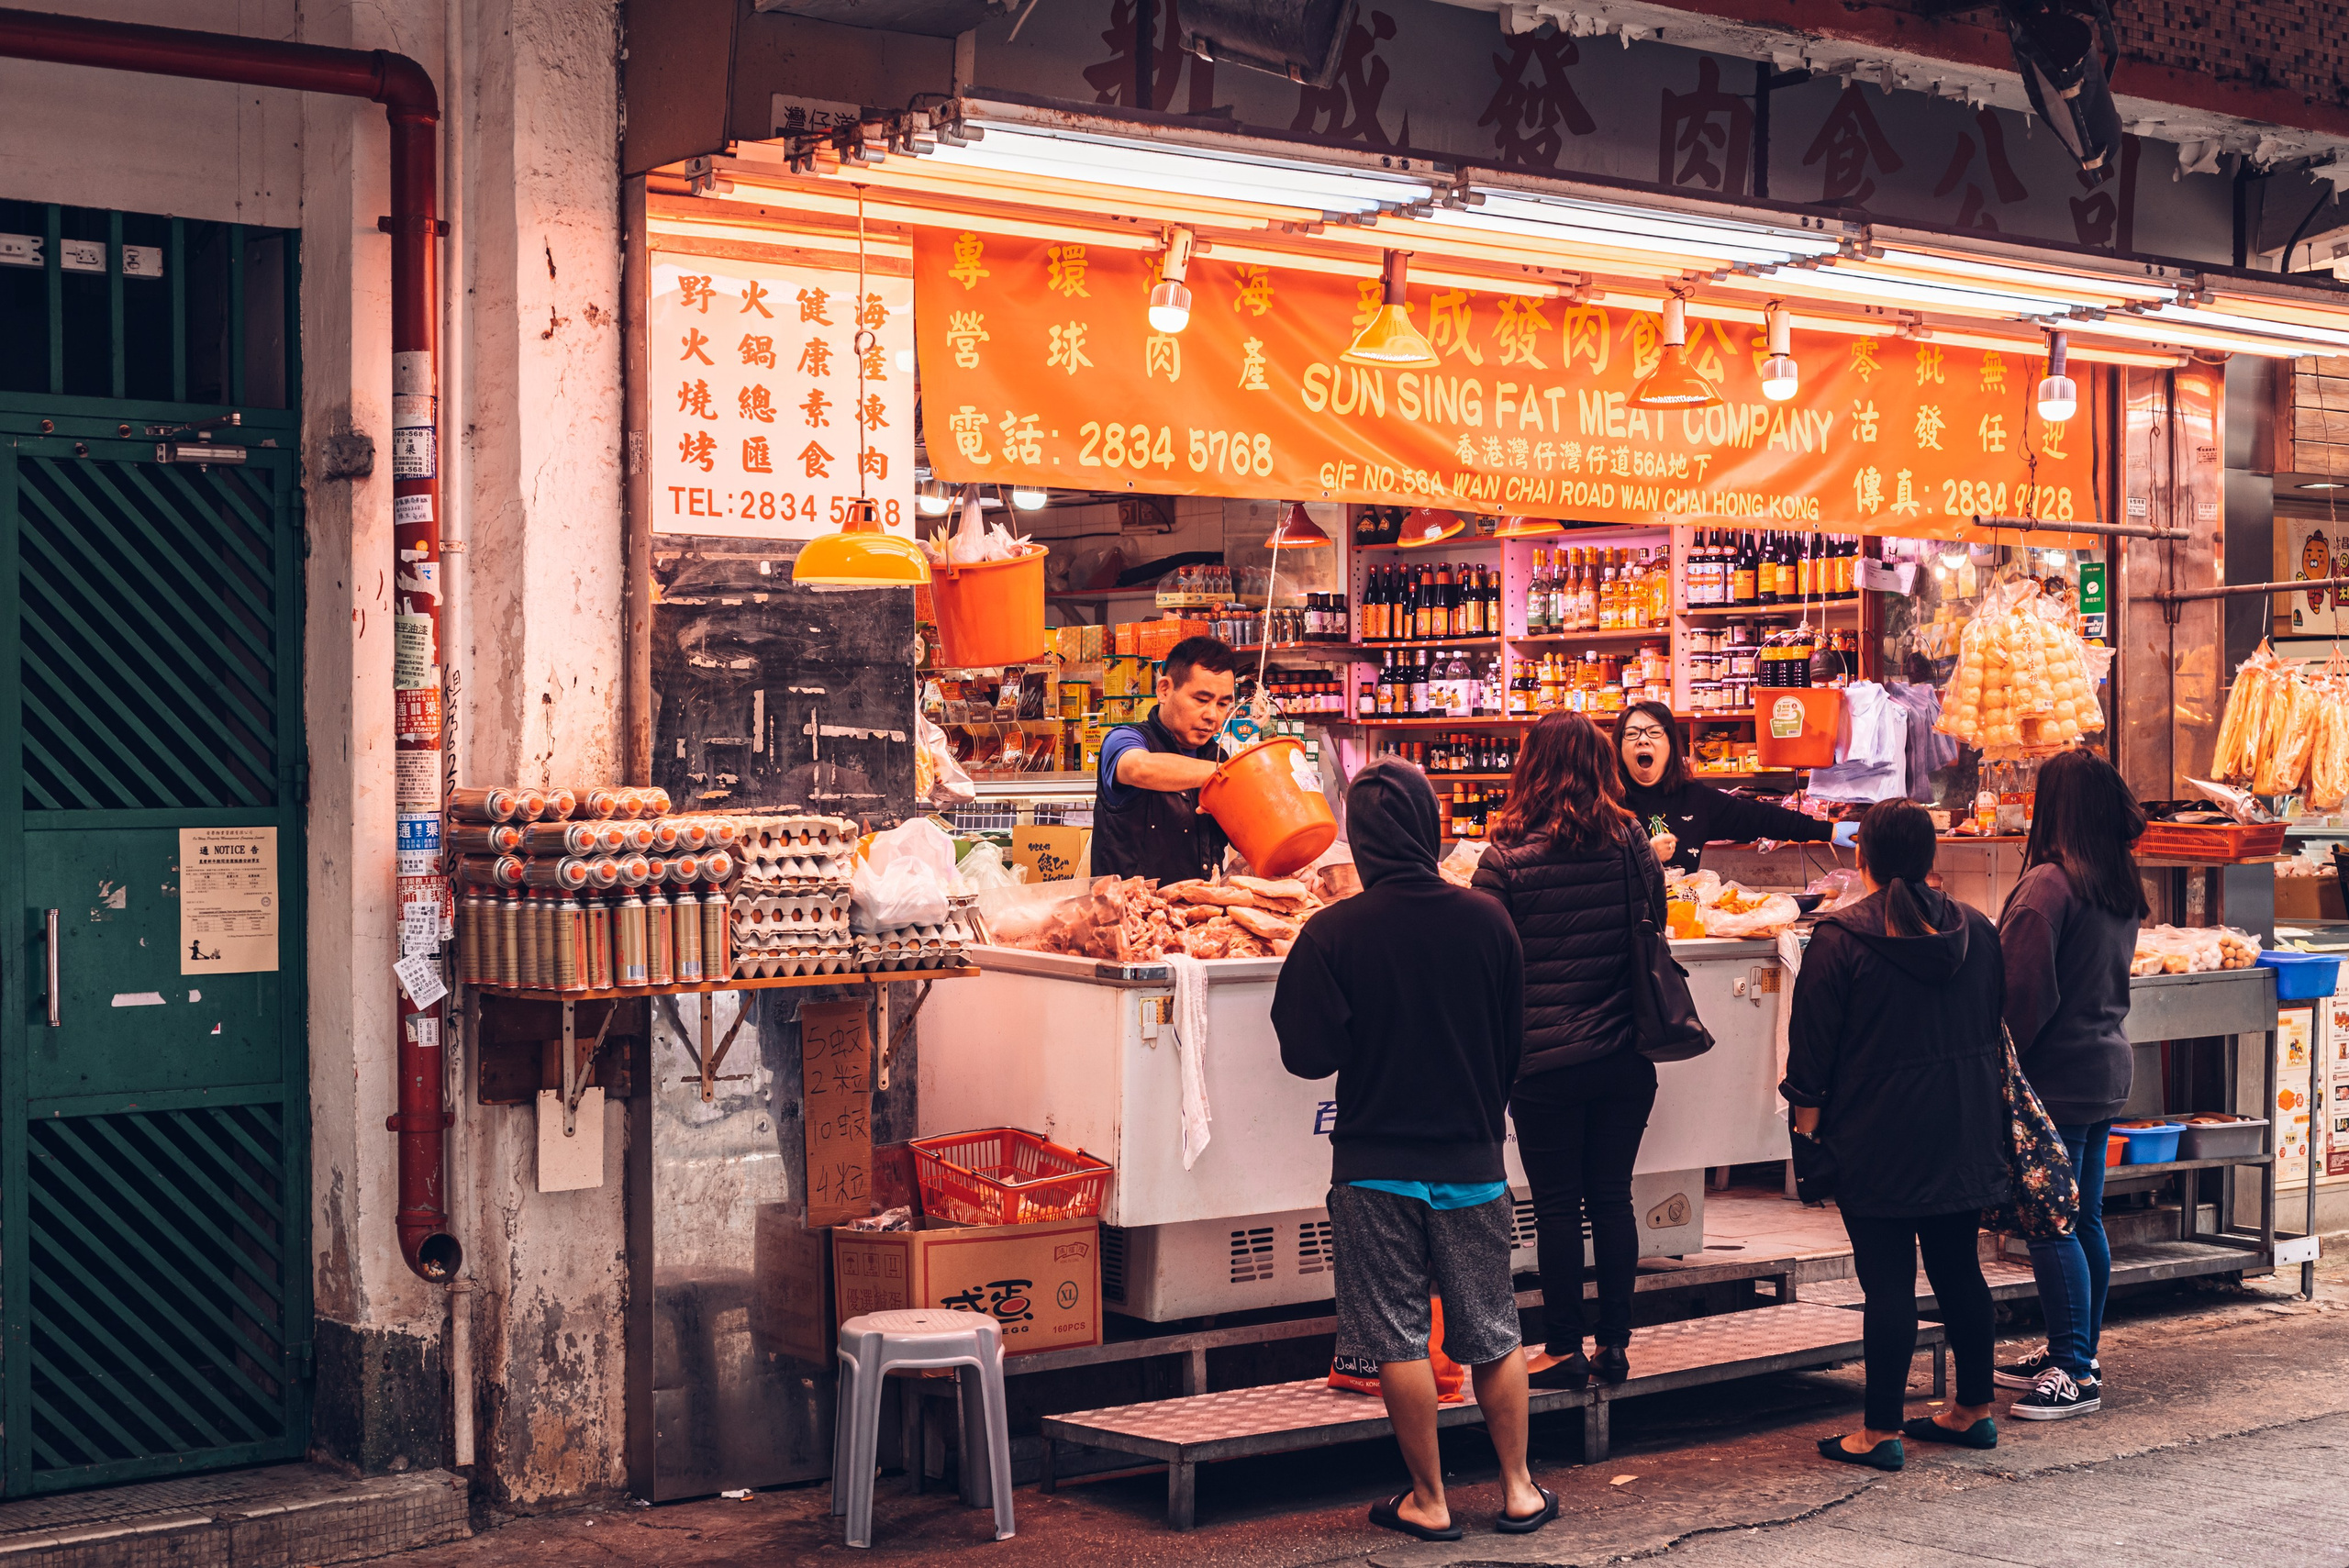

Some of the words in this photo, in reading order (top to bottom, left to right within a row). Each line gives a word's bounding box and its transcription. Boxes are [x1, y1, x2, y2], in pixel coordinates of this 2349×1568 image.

[946, 231, 990, 370] 專營
[1046, 244, 1094, 375] 環球
[1234, 264, 1275, 391] 海產
[677, 275, 718, 473] 野火燒烤
[737, 280, 777, 474] 火鍋總匯
[796, 287, 835, 479] 健康素食
[854, 292, 890, 481] 海產凍肉
[1301, 362, 1385, 419] SUN
[1397, 373, 1483, 428] SING
[1495, 383, 1565, 435] FAT
[1579, 389, 1666, 439] MEAT
[1682, 402, 1834, 454] COMPANY
[1848, 335, 1882, 443] 零沽
[1914, 343, 1946, 450] 批發
[1978, 349, 2008, 453] 無任
[2042, 358, 2068, 460] 迎
[1078, 421, 1175, 471] 2834
[1187, 427, 1275, 477] 5768
[1319, 460, 1355, 493] G/F
[1452, 472, 1498, 500] WAN
[1505, 476, 1554, 504] CHAI
[1559, 481, 1613, 509] ROAD
[1620, 485, 1660, 513] WAN
[1664, 487, 1707, 515] CHAI
[1712, 490, 1764, 518] HONG
[1768, 494, 1819, 521] KONG
[1454, 433, 1712, 484] 香港灣仔灣仔道56A地下
[1942, 478, 2008, 517] 2834
[829, 495, 901, 528] 58
[425, 701, 437, 716] 渠
[199, 845, 209, 856] 通
[214, 845, 246, 855] NOTICE
[250, 844, 260, 855] 告
[398, 822, 411, 839] 通
[426, 821, 439, 838] 渠
[1052, 1321, 1085, 1334] 160PCS
[1061, 1288, 1076, 1303] XL
